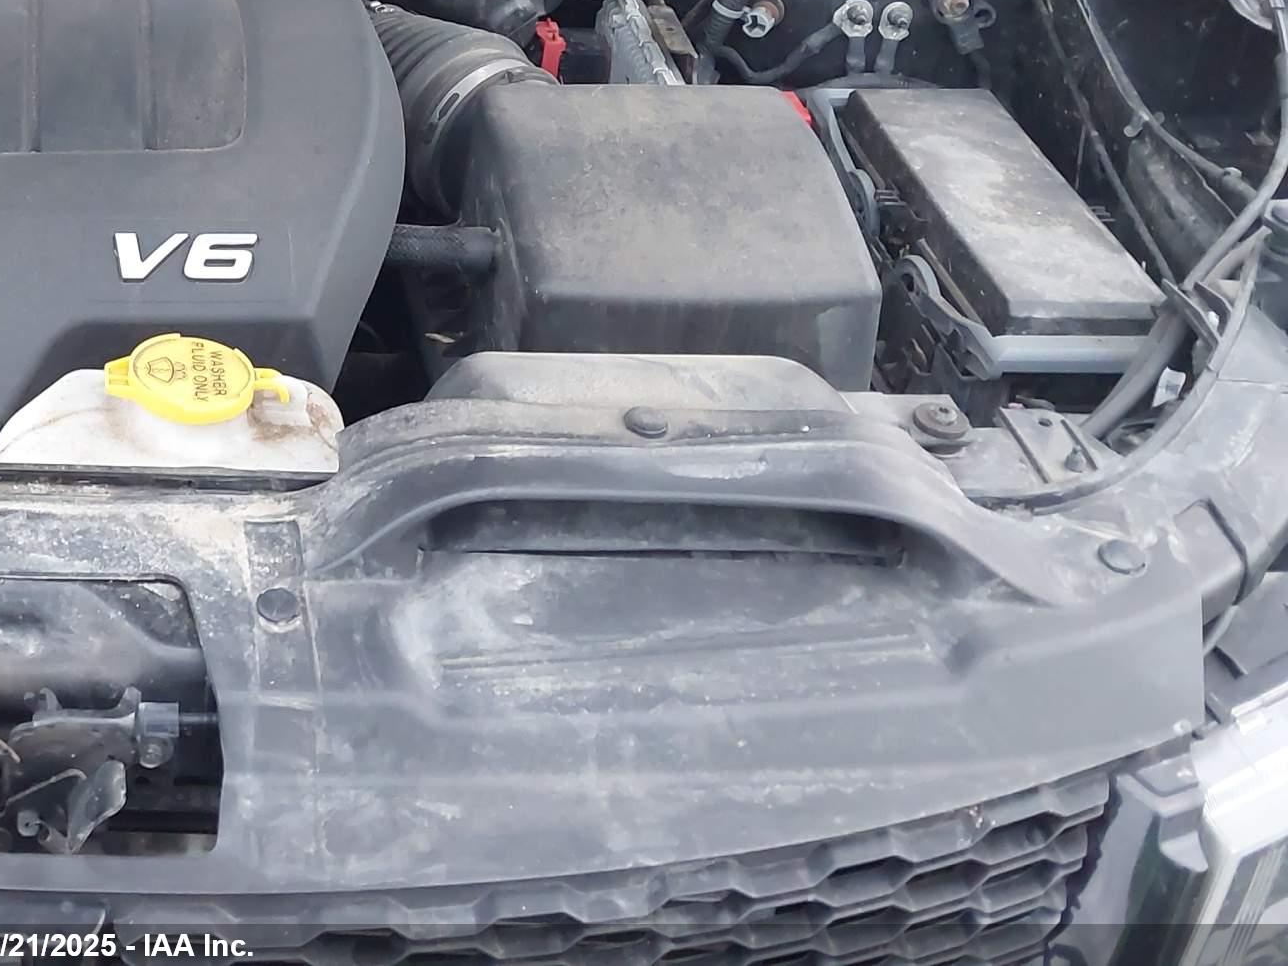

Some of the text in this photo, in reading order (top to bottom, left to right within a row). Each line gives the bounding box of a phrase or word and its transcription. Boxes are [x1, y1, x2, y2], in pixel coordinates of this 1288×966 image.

[113, 233, 259, 283] V6
[191, 341, 209, 402] FLUID ONLY
[210, 350, 227, 396] WASHER
